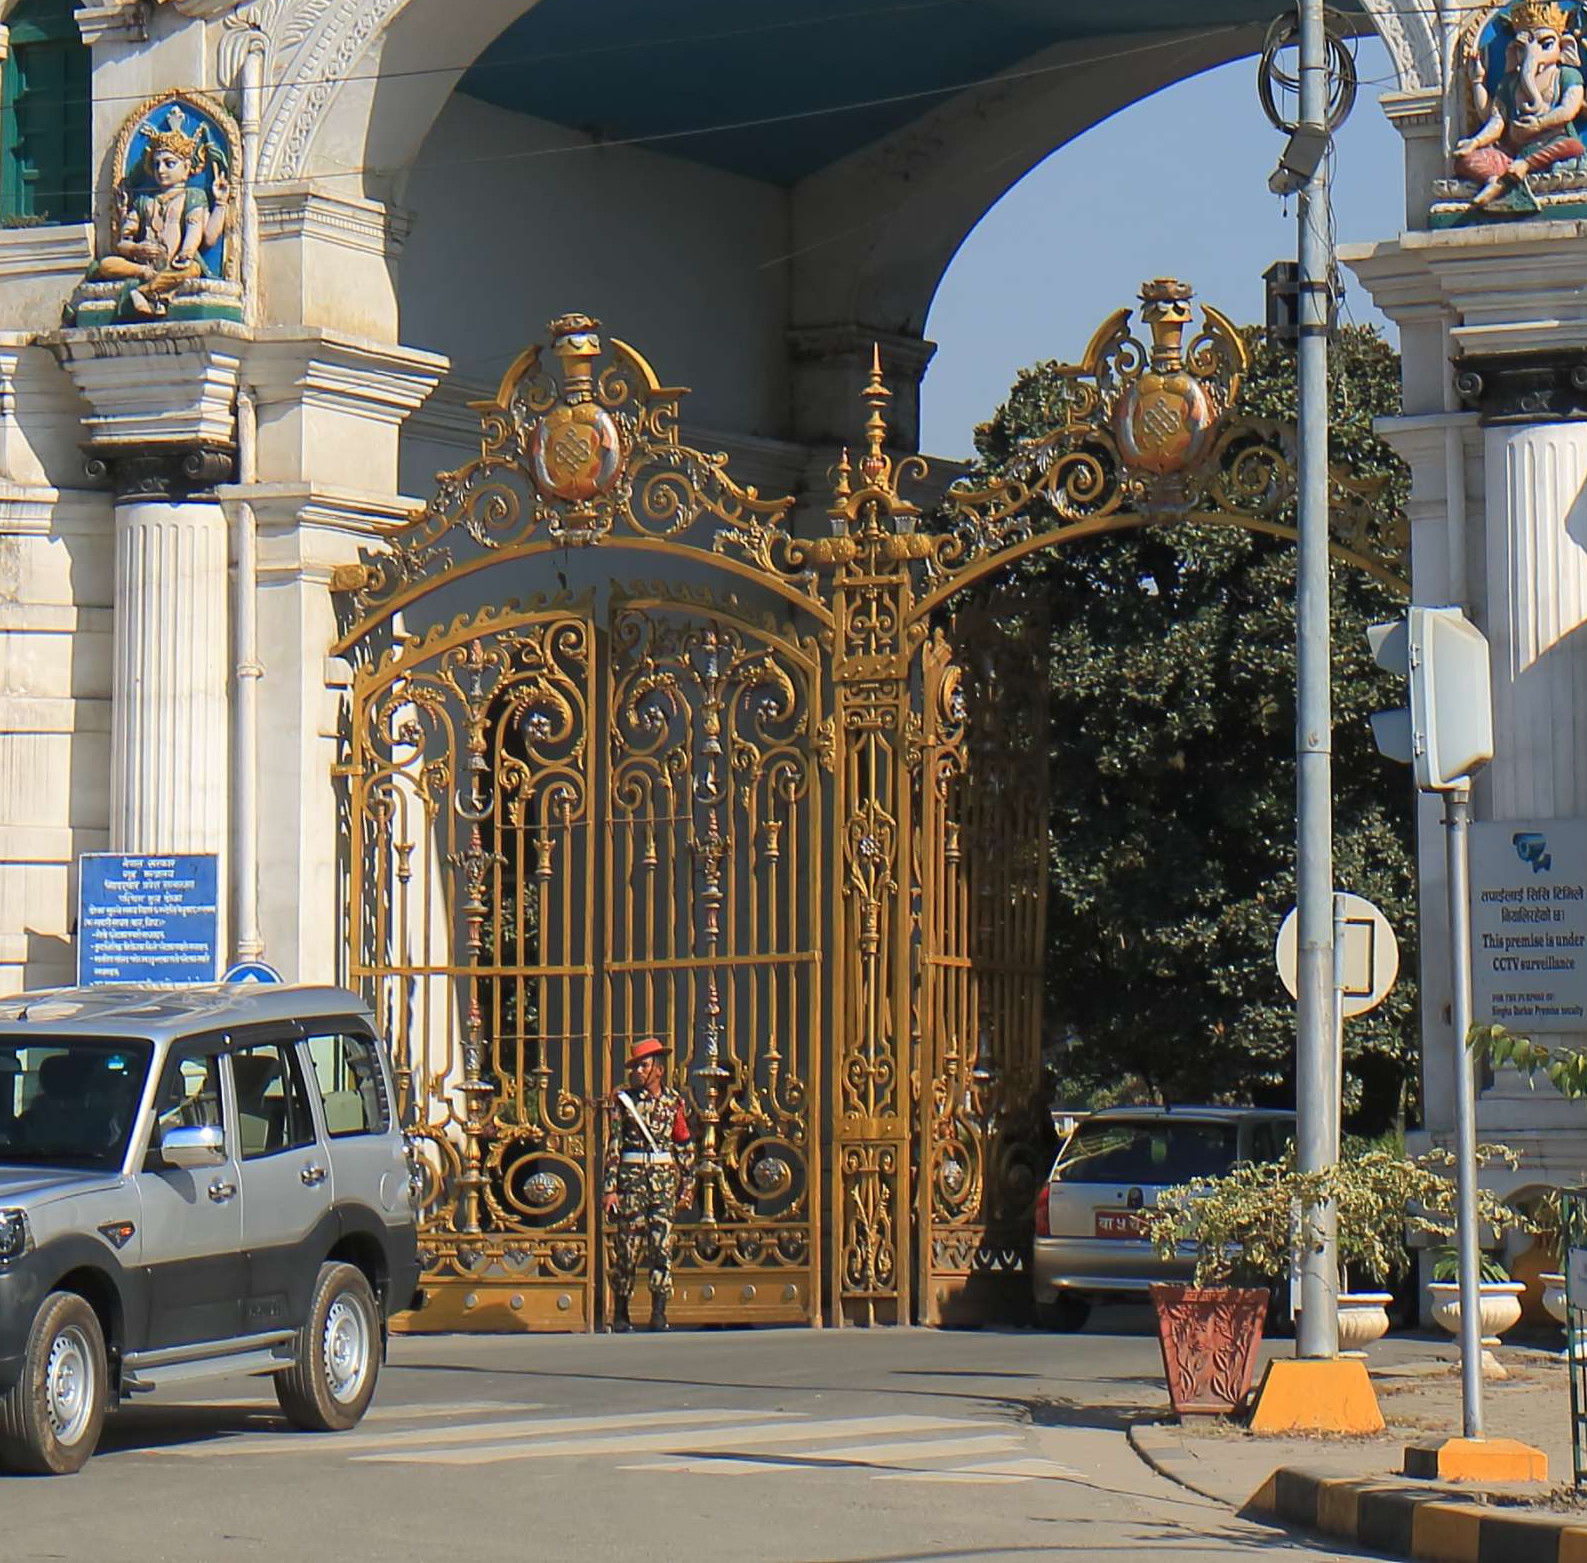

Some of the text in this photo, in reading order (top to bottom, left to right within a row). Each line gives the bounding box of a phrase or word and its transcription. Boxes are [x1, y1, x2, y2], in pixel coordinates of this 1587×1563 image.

[1481, 931, 1585, 952] This premise is under
[1492, 955, 1575, 971] CCTV surveillance
